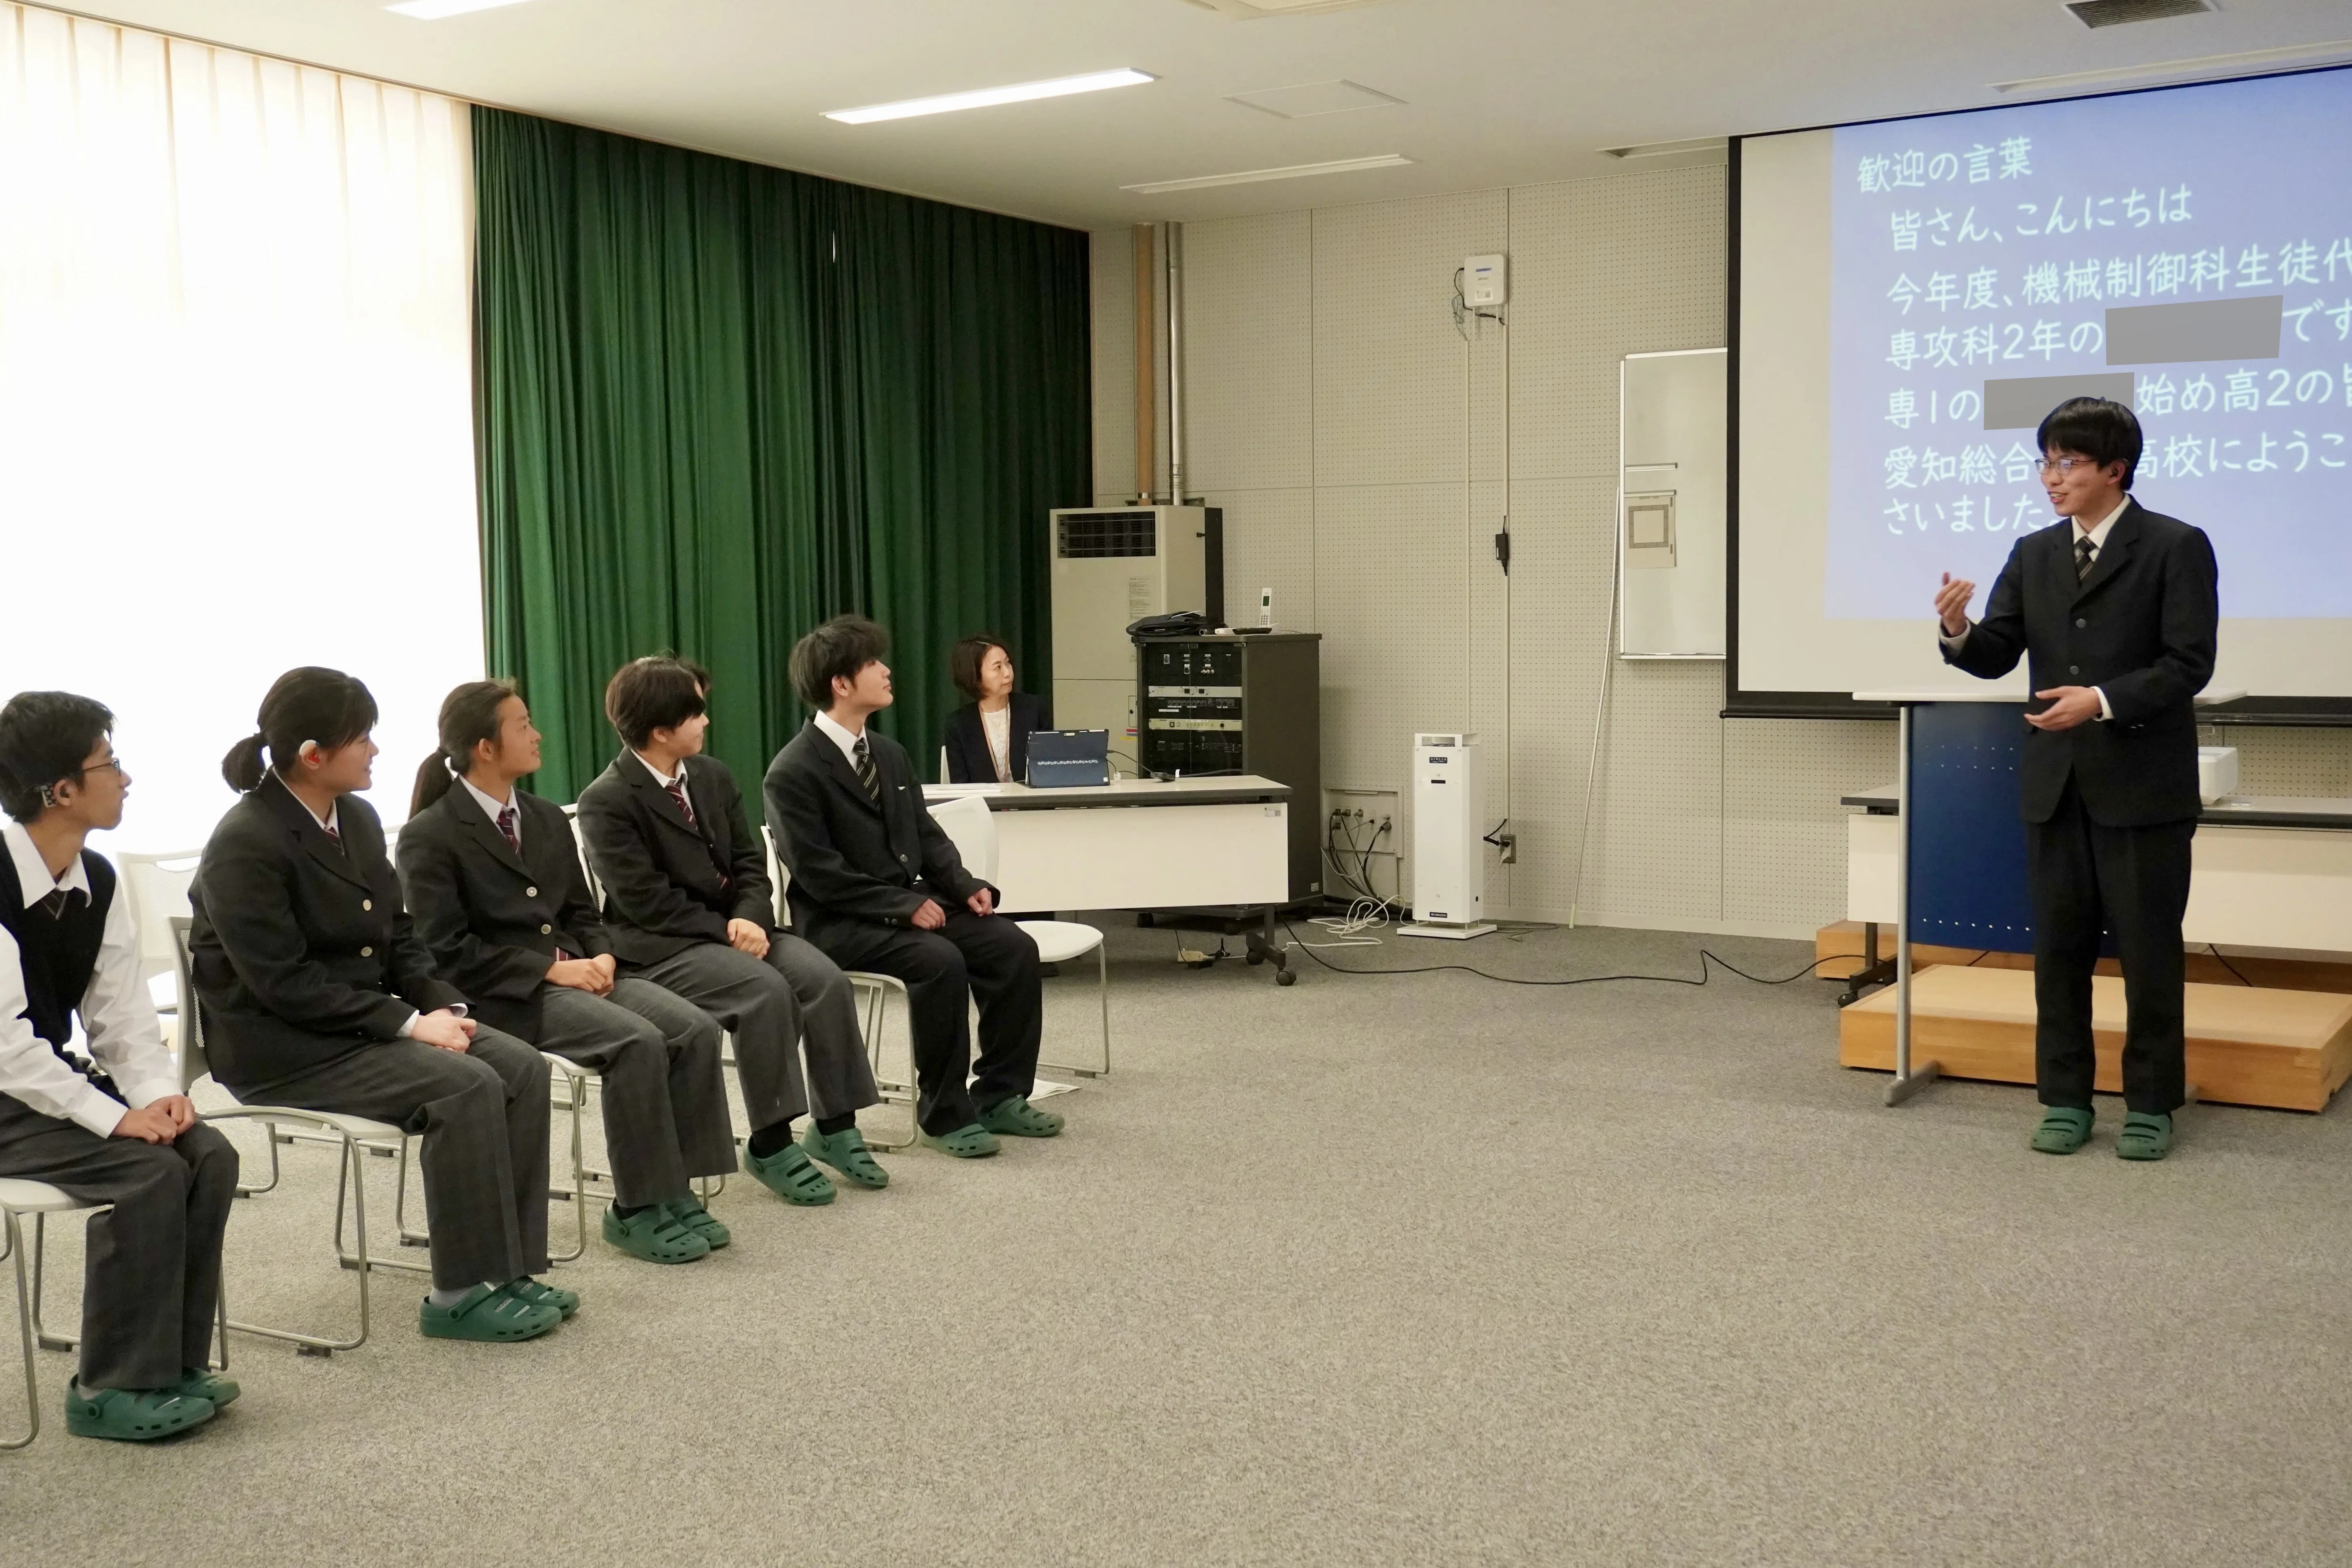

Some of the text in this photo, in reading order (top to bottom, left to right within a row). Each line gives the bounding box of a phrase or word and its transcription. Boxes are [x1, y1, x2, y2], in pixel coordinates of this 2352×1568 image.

[1857, 136, 2032, 194] 歓迎の言葉
[1890, 182, 2192, 252] 皆さん、こんにちは
[1885, 319, 2104, 370] 専攻科2年の
[2135, 362, 2352, 416] 始め高2の
